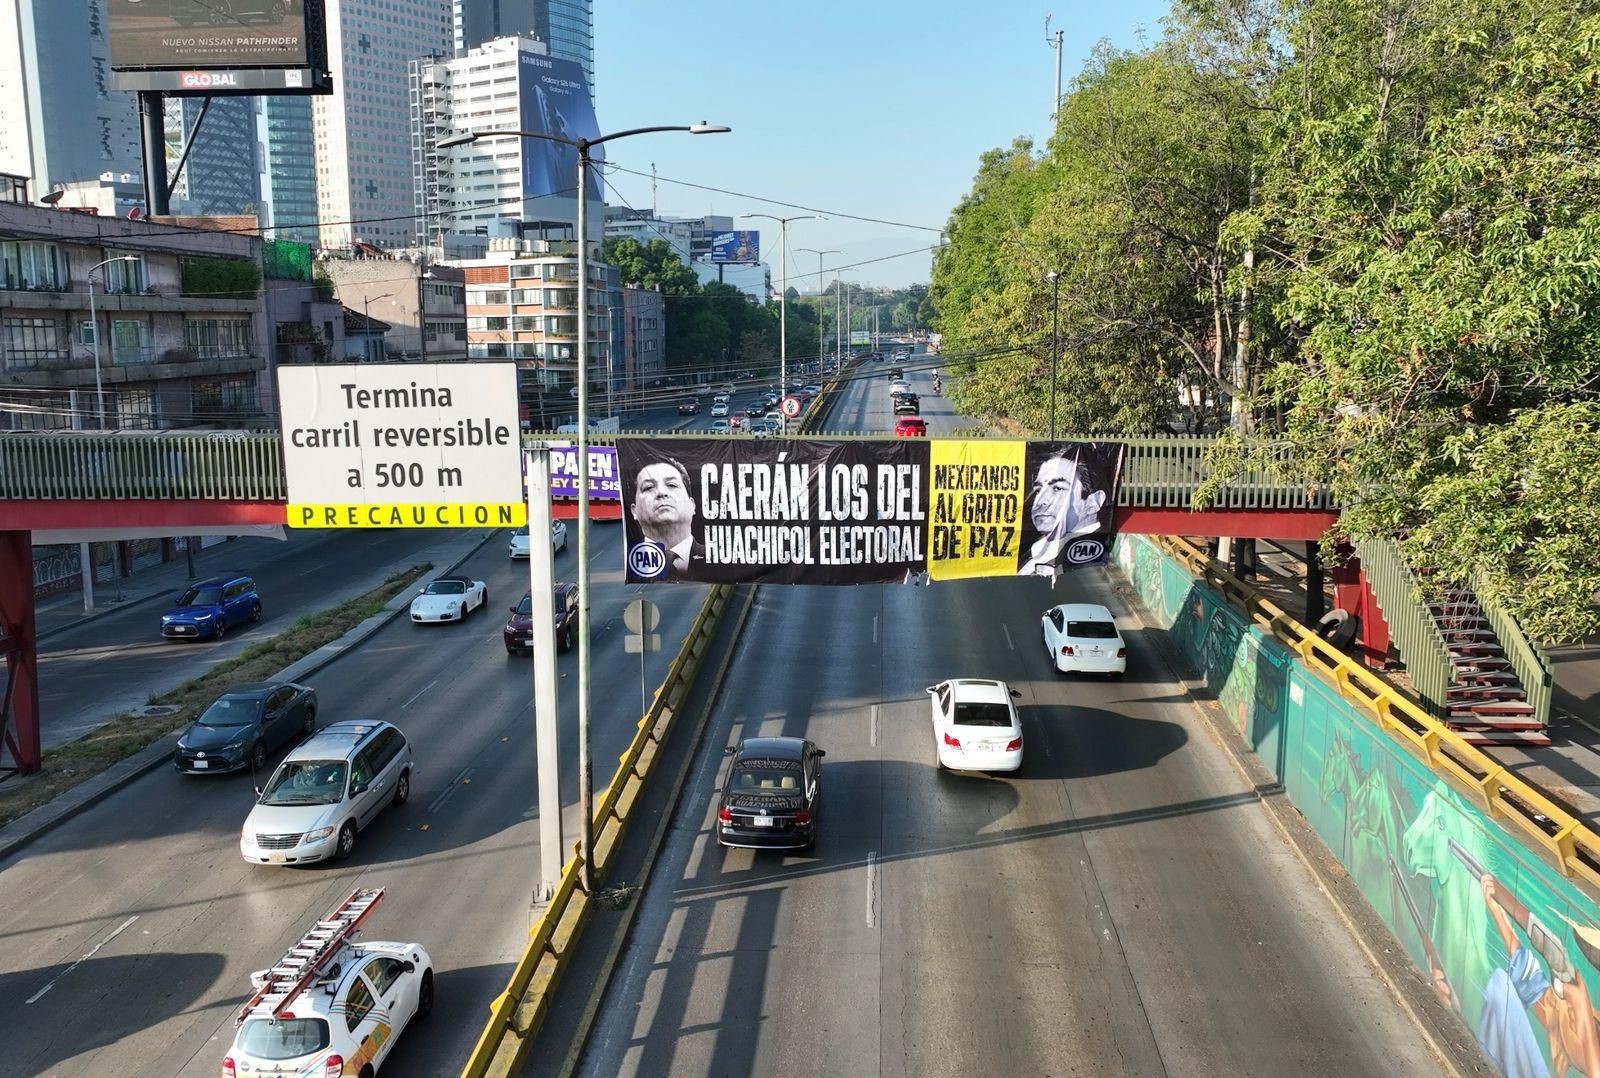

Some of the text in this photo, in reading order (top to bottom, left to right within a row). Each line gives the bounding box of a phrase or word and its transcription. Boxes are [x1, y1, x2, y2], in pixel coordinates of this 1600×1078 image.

[162, 37, 298, 47] NUEVO NISSAN PATHFINDER
[521, 55, 552, 69] SAMSUNG
[184, 73, 237, 86] GLOBAL
[541, 75, 560, 86] Galaxy
[341, 382, 452, 409] Termina
[291, 418, 510, 448] carril reversible
[347, 462, 463, 488] a 500 m
[701, 451, 925, 521] CAERÁN LOS DEL
[935, 465, 1020, 491] MEXICANOS
[302, 505, 512, 525] PRECAUCION
[934, 493, 1018, 524] AL GRITO
[704, 525, 924, 565] HUACHICOL ELECTORAL
[932, 525, 1015, 561] DE PAZ
[1071, 544, 1097, 558] PAN
[635, 551, 659, 568] PAN
